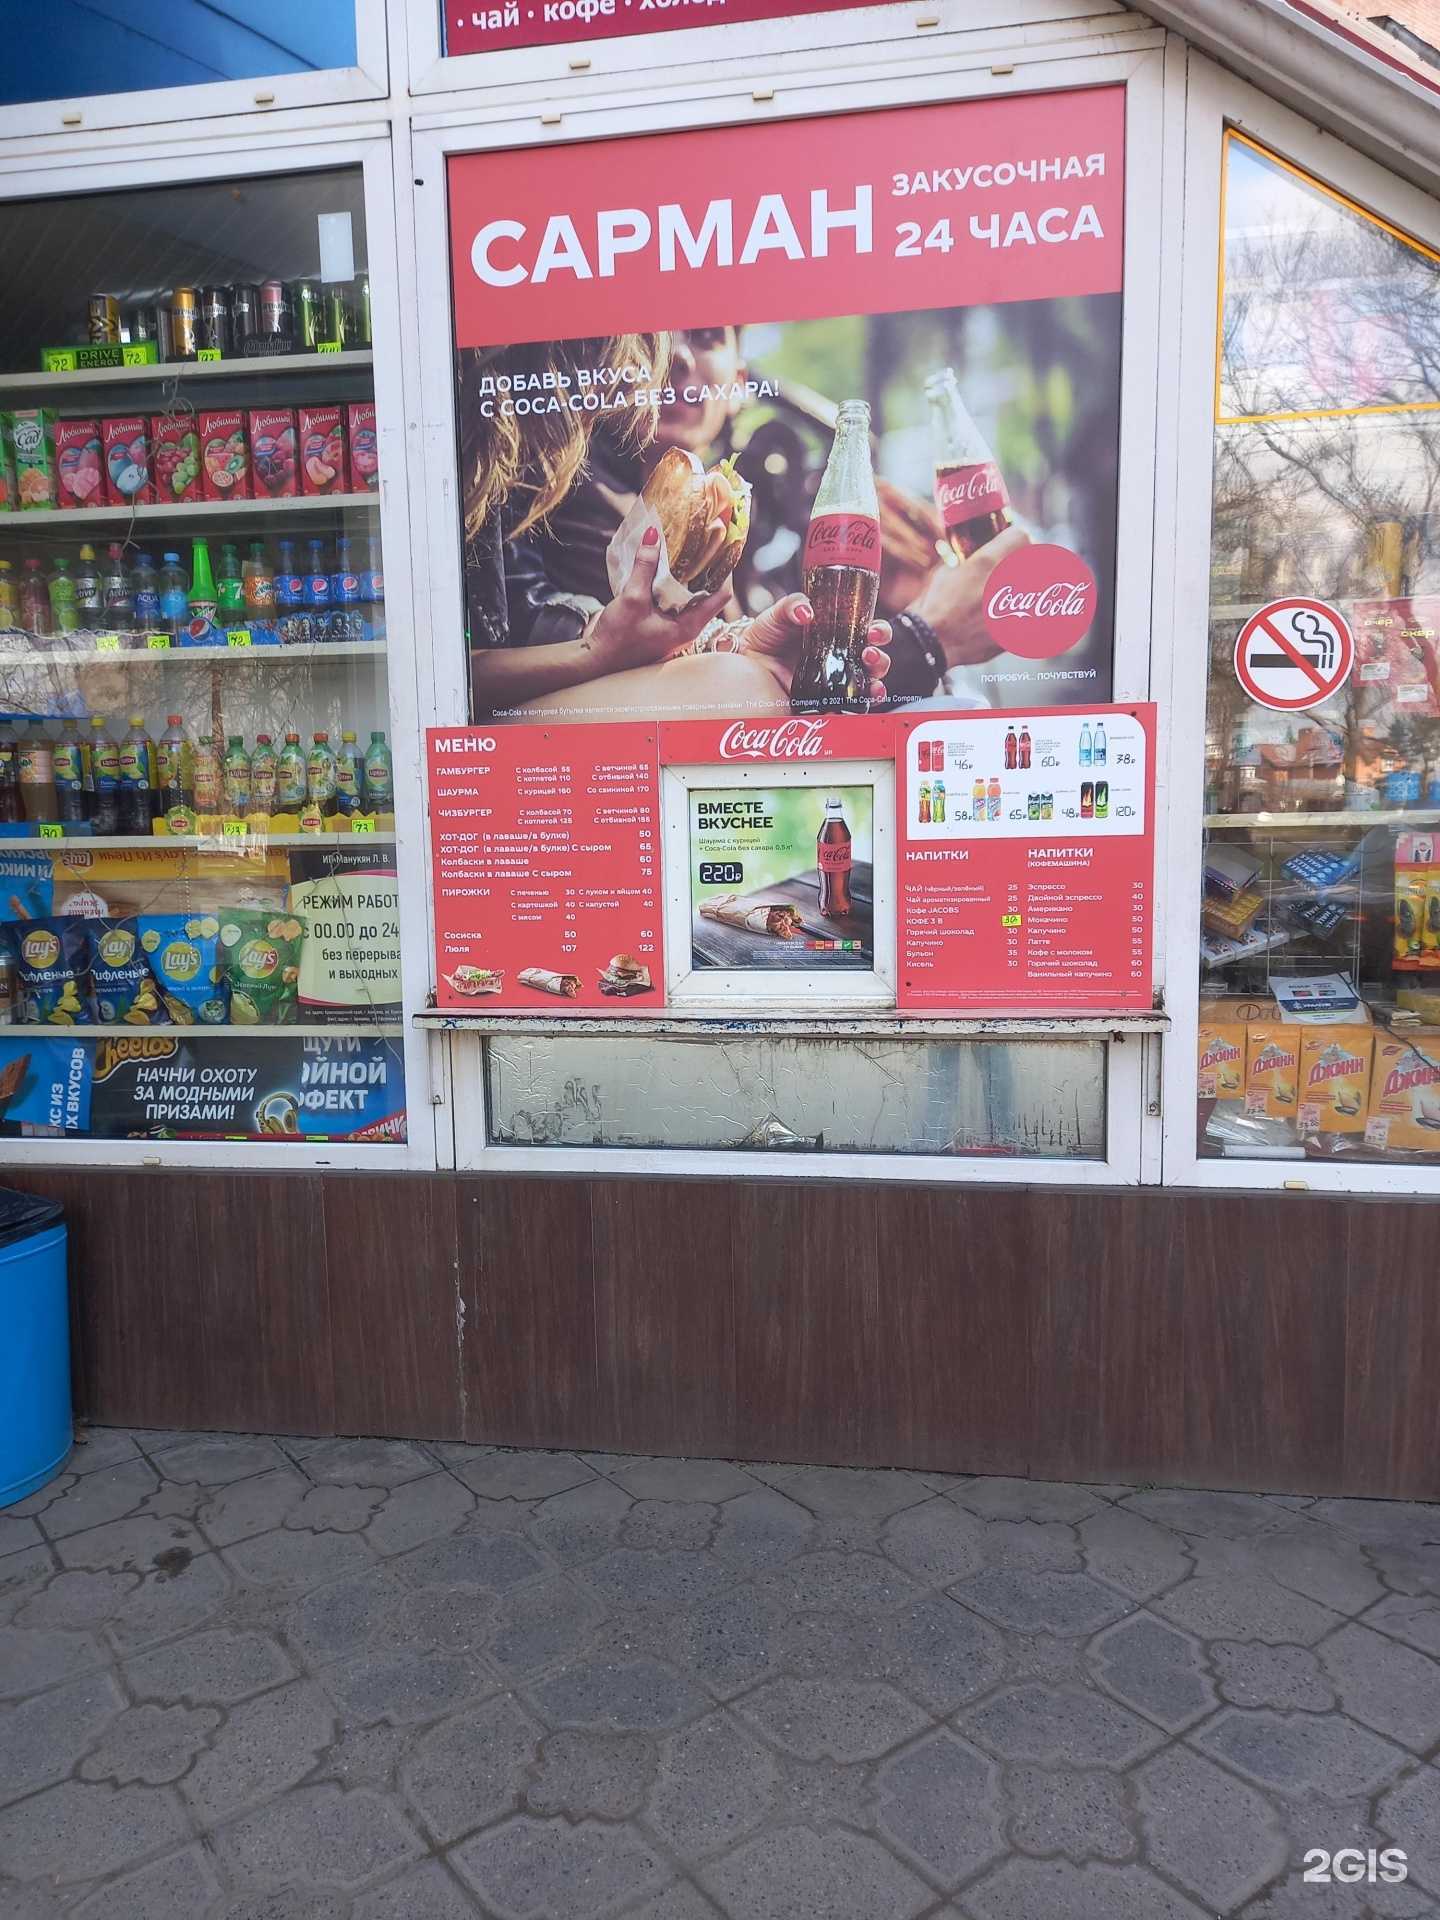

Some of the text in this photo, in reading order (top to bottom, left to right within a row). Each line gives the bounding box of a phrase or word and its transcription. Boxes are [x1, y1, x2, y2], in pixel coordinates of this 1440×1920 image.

[472, 0, 615, 29] чай кофе
[892, 153, 1105, 196] ЗАКУСОЧНАЯ
[471, 184, 872, 287] САРМАН
[895, 204, 1104, 258] 24 ЧАСА
[80, 350, 119, 359] DRIVE
[479, 366, 652, 397] ДОБАВЬ ВКУСА
[480, 380, 779, 417] С COCA-COLA БЕЗ САХАРА!
[988, 582, 1090, 618] Coca-Cola
[719, 719, 830, 759] Coca-Cola
[436, 738, 496, 752] МЕНЮ
[437, 767, 490, 775] ГАМБУРГЕР
[438, 788, 479, 797] ШАУРМА
[524, 788, 556, 796] курицей
[439, 809, 492, 817] ЧИЗБУРГЕР
[698, 802, 764, 814] ВМЕСТЕ
[698, 817, 774, 829] ВКУСНЕЕ
[440, 830, 651, 841] ХОТ-ДОГ лаваше/в булке) 50
[441, 845, 479, 854] ХОТ-ДОГ
[494, 844, 538, 853] лаваше/в
[541, 843, 570, 853] булке)
[581, 844, 611, 852] сыром
[1029, 848, 1093, 859] НАПИТКИ
[337, 855, 371, 865] Манукян
[441, 857, 484, 866] Колбаски
[906, 851, 968, 861] НАПИТКИ
[1028, 859, 1090, 868] (КОФЕМАШИНА)
[442, 870, 484, 878] Колбаски
[495, 870, 529, 878] лаваше
[539, 869, 571, 878] сыром
[442, 888, 490, 897] ПИРОЖКИ
[586, 888, 608, 896] луком
[905, 885, 922, 893] ЧАЙ
[303, 895, 399, 909] РЕЖИМ РАБОТ
[1028, 894, 1063, 902] Двойной
[586, 900, 619, 908] капустой
[928, 906, 960, 914] JACOBS
[1028, 916, 1068, 924] Мокачино
[314, 923, 399, 940] 00.00 до 24
[907, 929, 937, 937] Горячий
[940, 928, 974, 936] шоколад
[1028, 927, 1066, 935] Капучино
[24, 940, 57, 959] Lay's
[323, 949, 341, 960] без
[445, 945, 469, 953] Люля
[1028, 949, 1048, 957] Кофе
[164, 950, 198, 973] Lay's
[329, 969, 398, 980] и выходных
[68, 1048, 85, 1111] ВКУСОВ
[137, 1067, 257, 1083] НАЧНИ ОХОТУ
[52, 1084, 63, 1105] ИЗ
[134, 1085, 255, 1102] ЗА МОДНЫМИ
[146, 1104, 235, 1120] ПРИЗАМИ!
